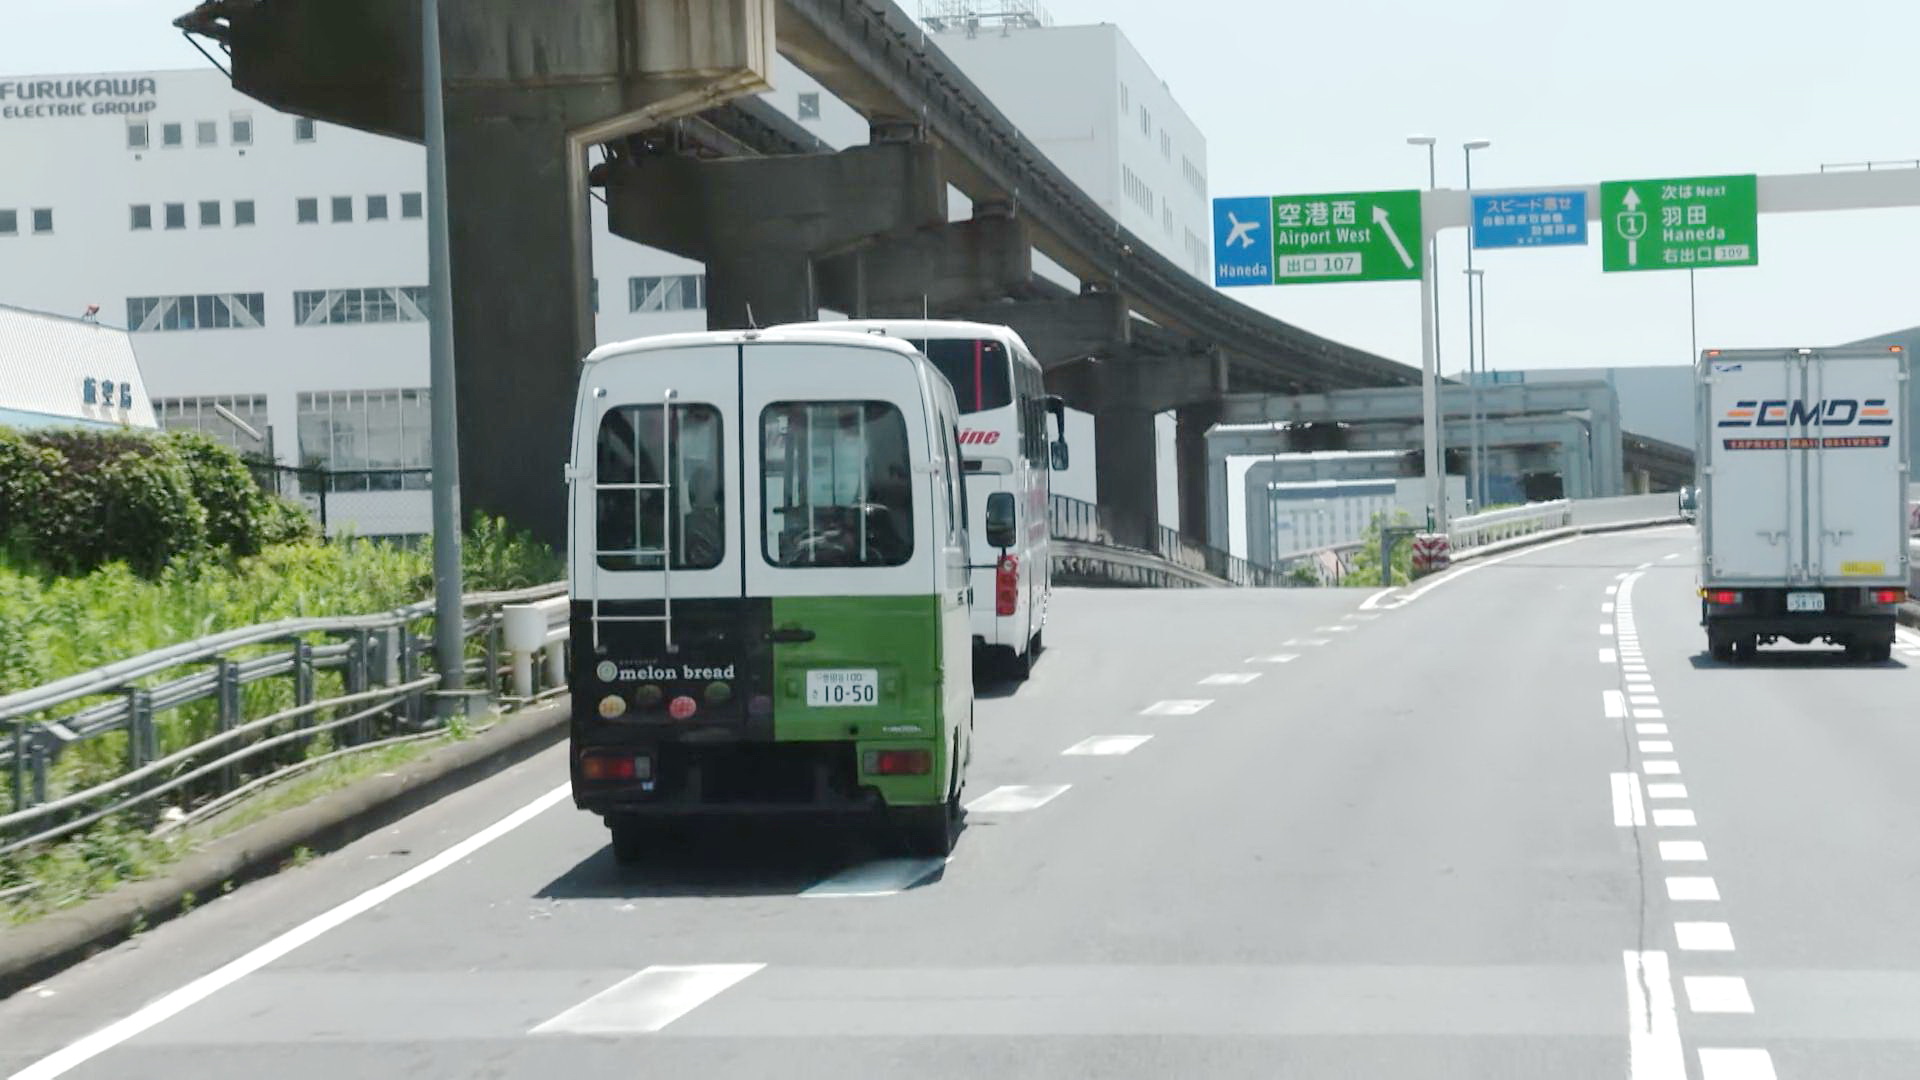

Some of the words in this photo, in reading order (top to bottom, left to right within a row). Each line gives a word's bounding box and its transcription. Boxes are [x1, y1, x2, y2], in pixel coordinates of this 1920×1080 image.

[0, 78, 156, 100] FURUKAWA
[3, 102, 87, 118] ELECTRIC
[92, 101, 157, 115] GROUP
[1662, 185, 1693, 200] 次は
[1696, 186, 1726, 197] Next
[1278, 201, 1356, 227] 空港西
[1662, 205, 1707, 226] 羽田
[1626, 217, 1638, 233] 1
[1279, 229, 1331, 248] Airport
[1336, 228, 1371, 243] West
[1663, 226, 1726, 242] Haneda
[1664, 246, 1712, 263] 右出口
[1720, 248, 1743, 258] 109
[1219, 263, 1268, 277] Haneda
[1286, 259, 1317, 273] 出口
[1324, 257, 1354, 272] 107
[619, 665, 677, 680] melon
[683, 664, 735, 679] bread
[825, 684, 873, 703] 10-50
